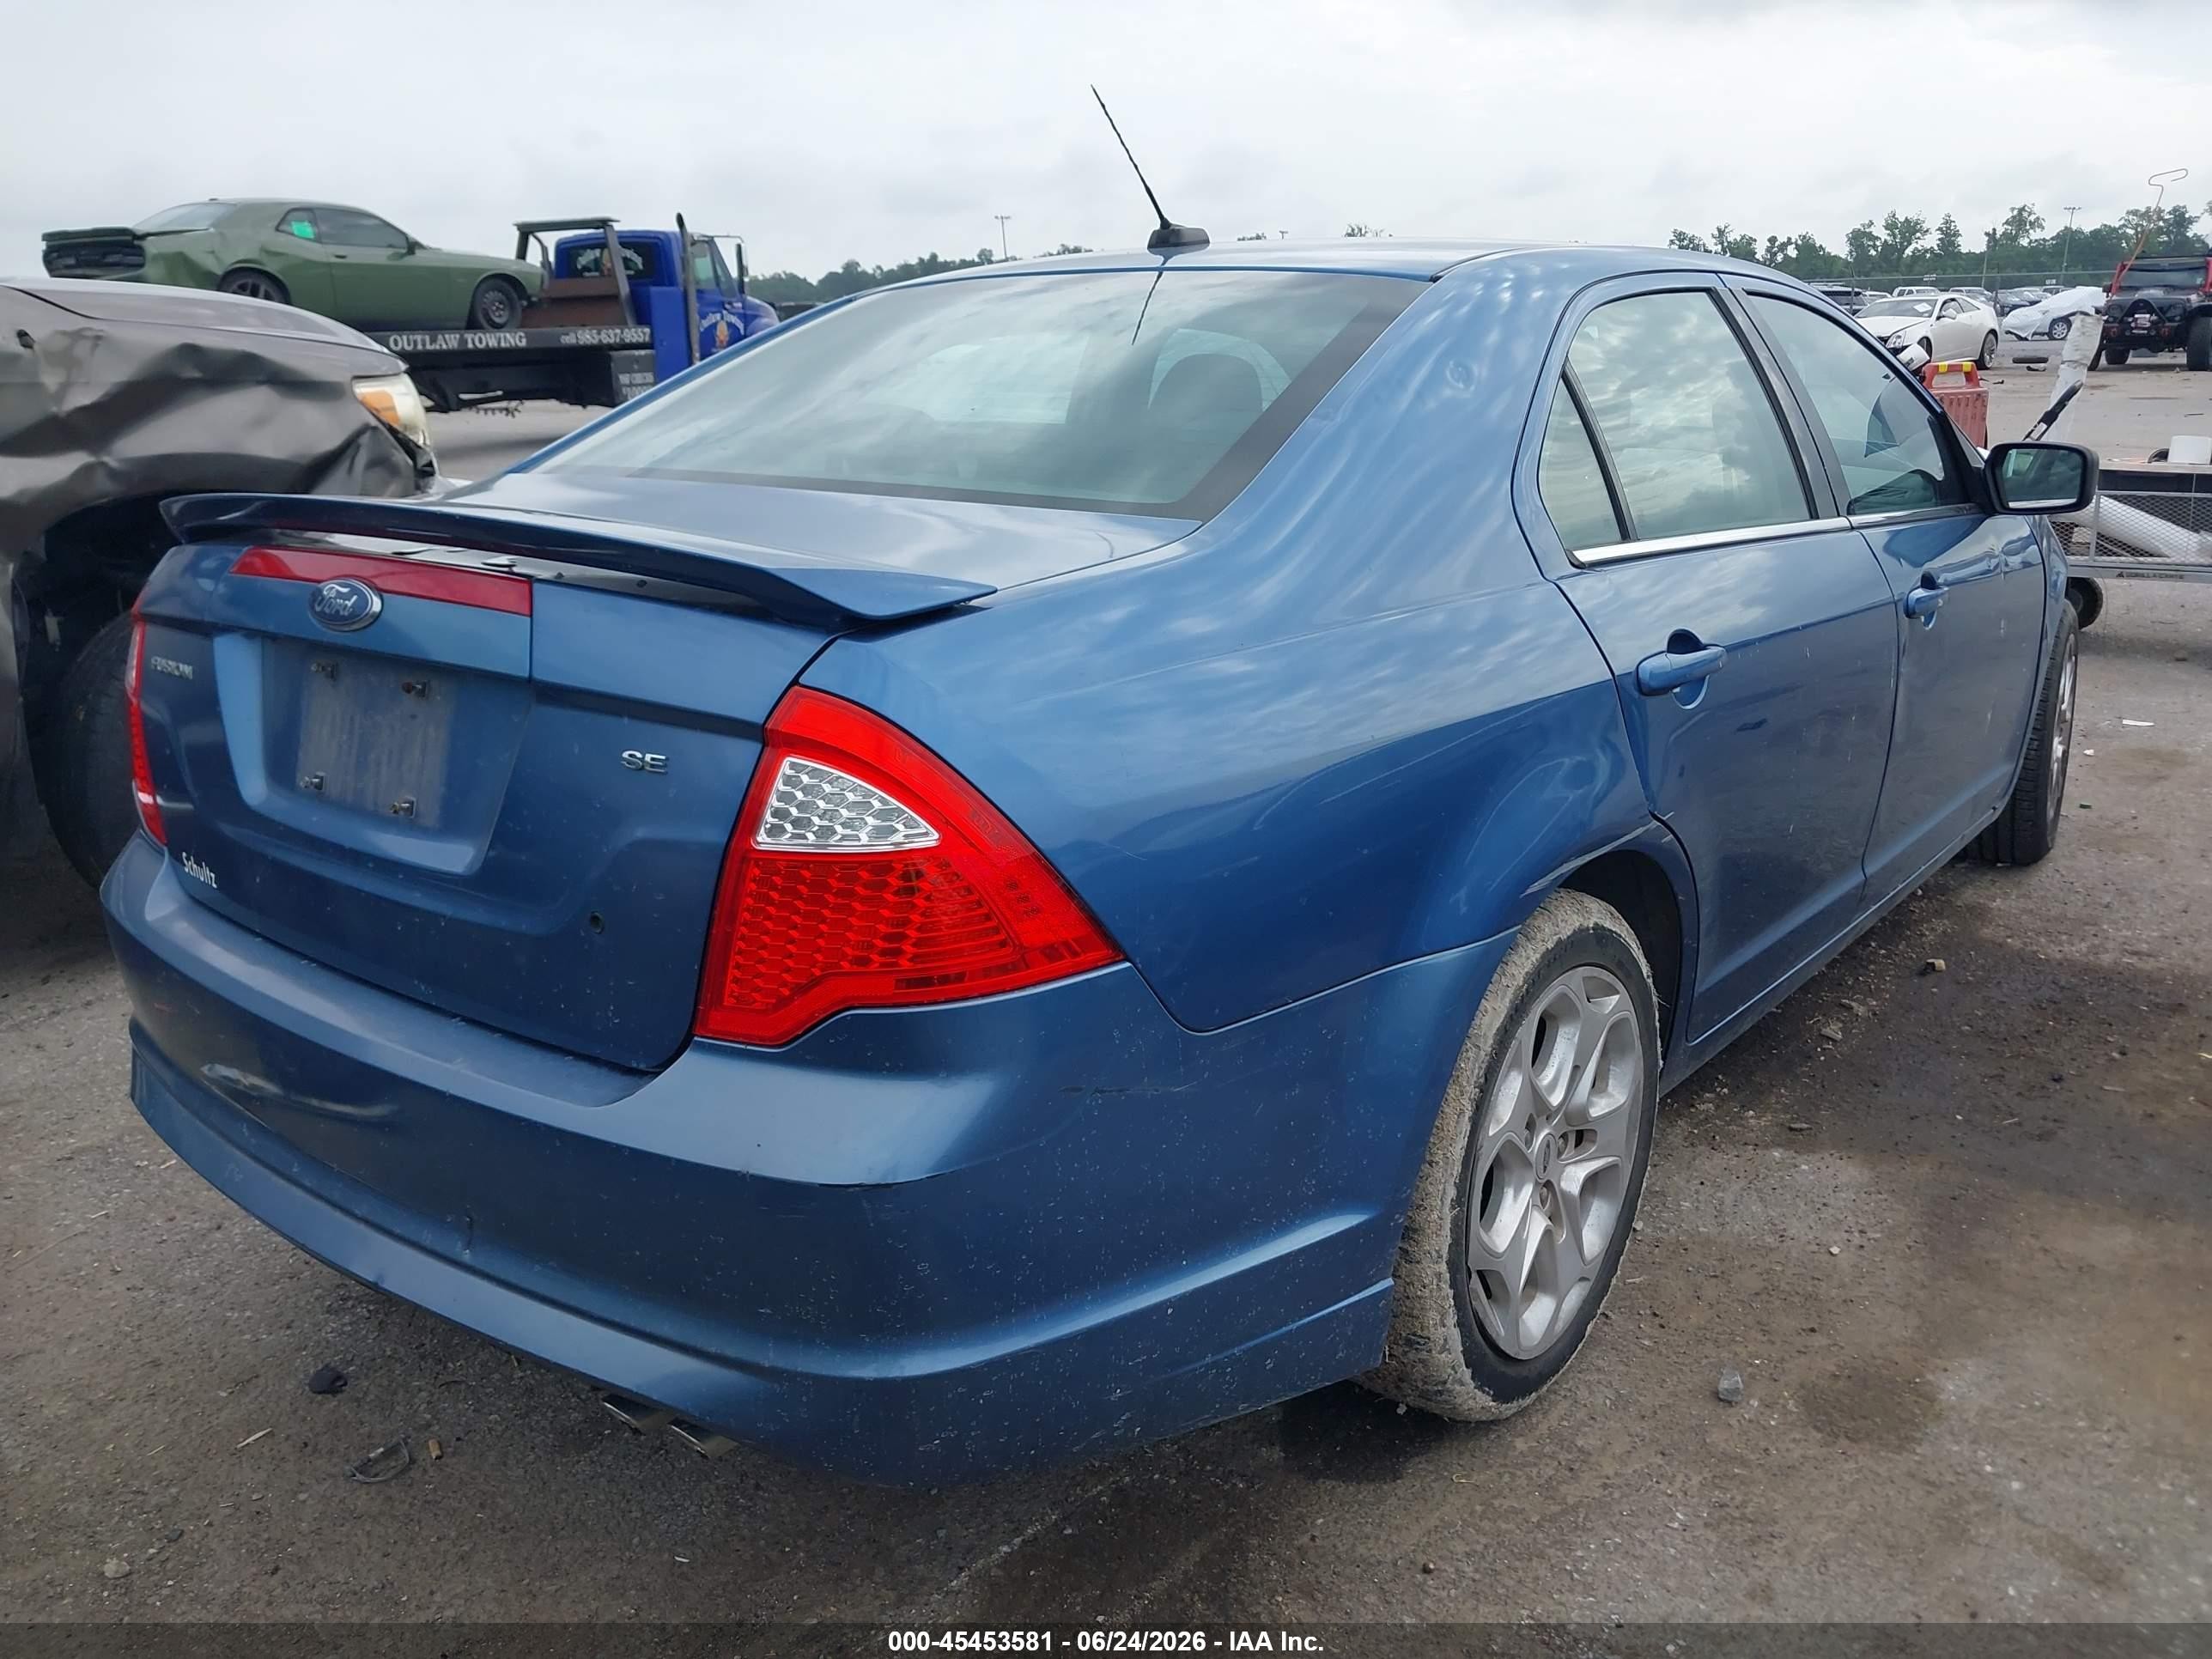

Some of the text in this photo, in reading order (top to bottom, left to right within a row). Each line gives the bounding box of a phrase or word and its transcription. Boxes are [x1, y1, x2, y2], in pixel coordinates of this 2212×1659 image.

[389, 333, 459, 351] OUTLAW
[464, 331, 527, 349] TOWING
[314, 583, 359, 616] Ford
[621, 750, 667, 772] SE
[182, 851, 217, 889] Schultz
